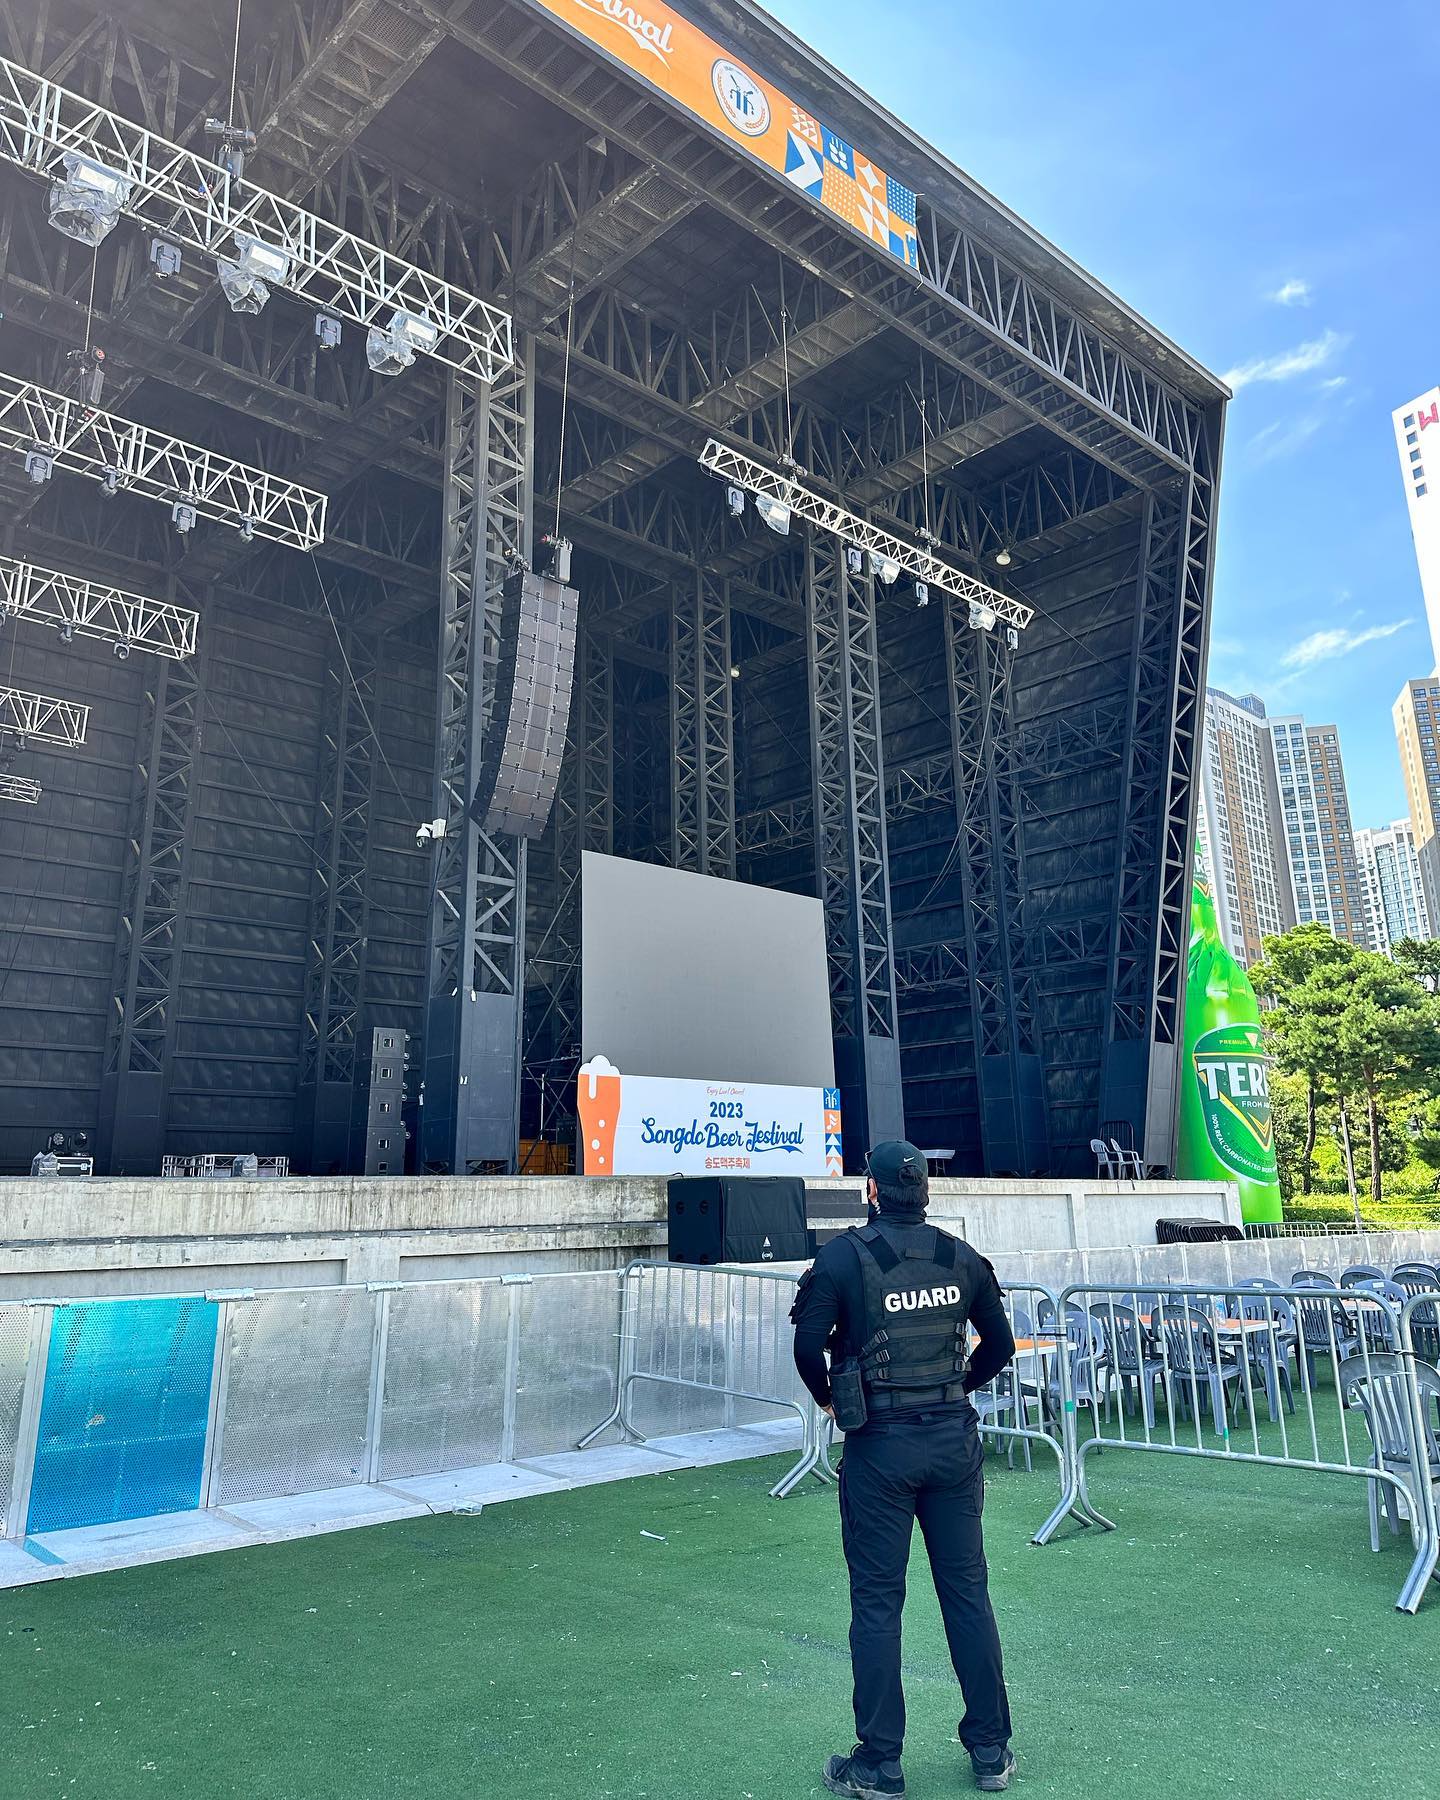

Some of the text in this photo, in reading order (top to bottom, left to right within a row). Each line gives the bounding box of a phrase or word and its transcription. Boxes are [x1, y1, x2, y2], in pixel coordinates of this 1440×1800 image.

[710, 1101, 743, 1118] 2023
[1241, 1100, 1263, 1108] FROM
[1211, 1113, 1220, 1129] 100%
[641, 1117, 804, 1154] Songdo Beer Festival
[1214, 1129, 1225, 1146] REAL
[704, 1156, 751, 1169] 송도맥주축제
[884, 1285, 961, 1313] GUARD
